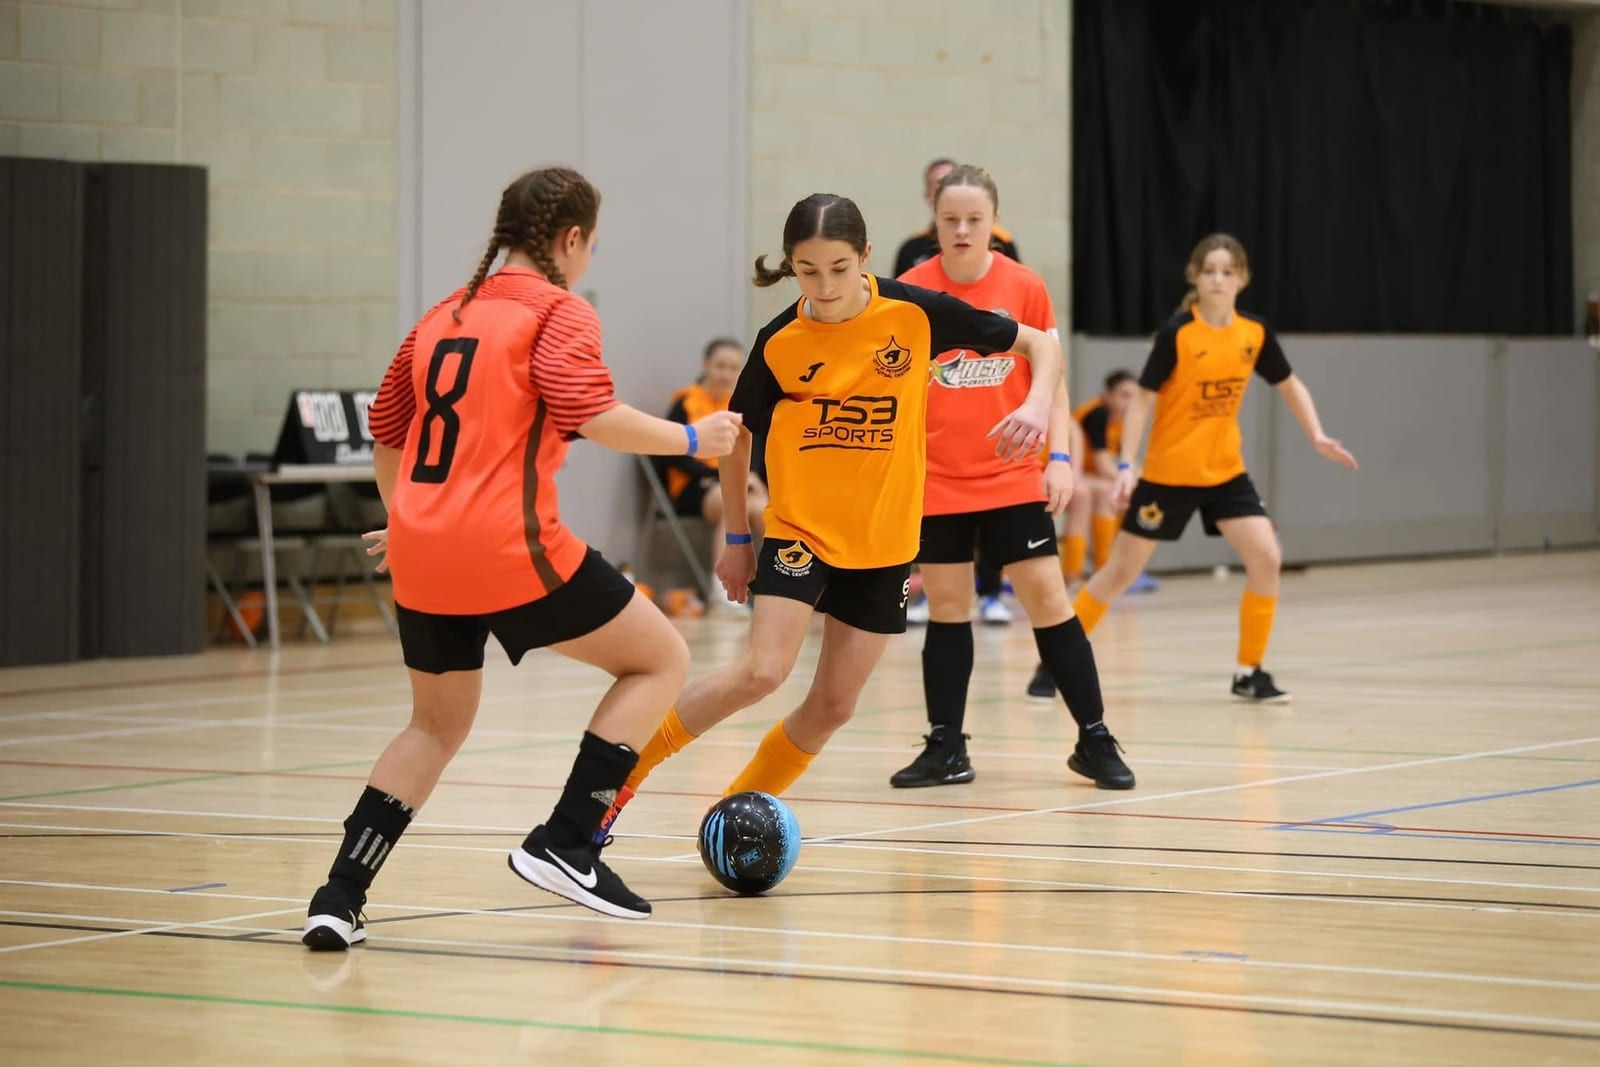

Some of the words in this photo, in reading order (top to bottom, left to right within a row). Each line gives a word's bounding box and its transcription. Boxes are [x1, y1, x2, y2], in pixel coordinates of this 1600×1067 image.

[410, 337, 479, 484] 8
[812, 395, 897, 425] TS3
[803, 426, 893, 443] SPORTS
